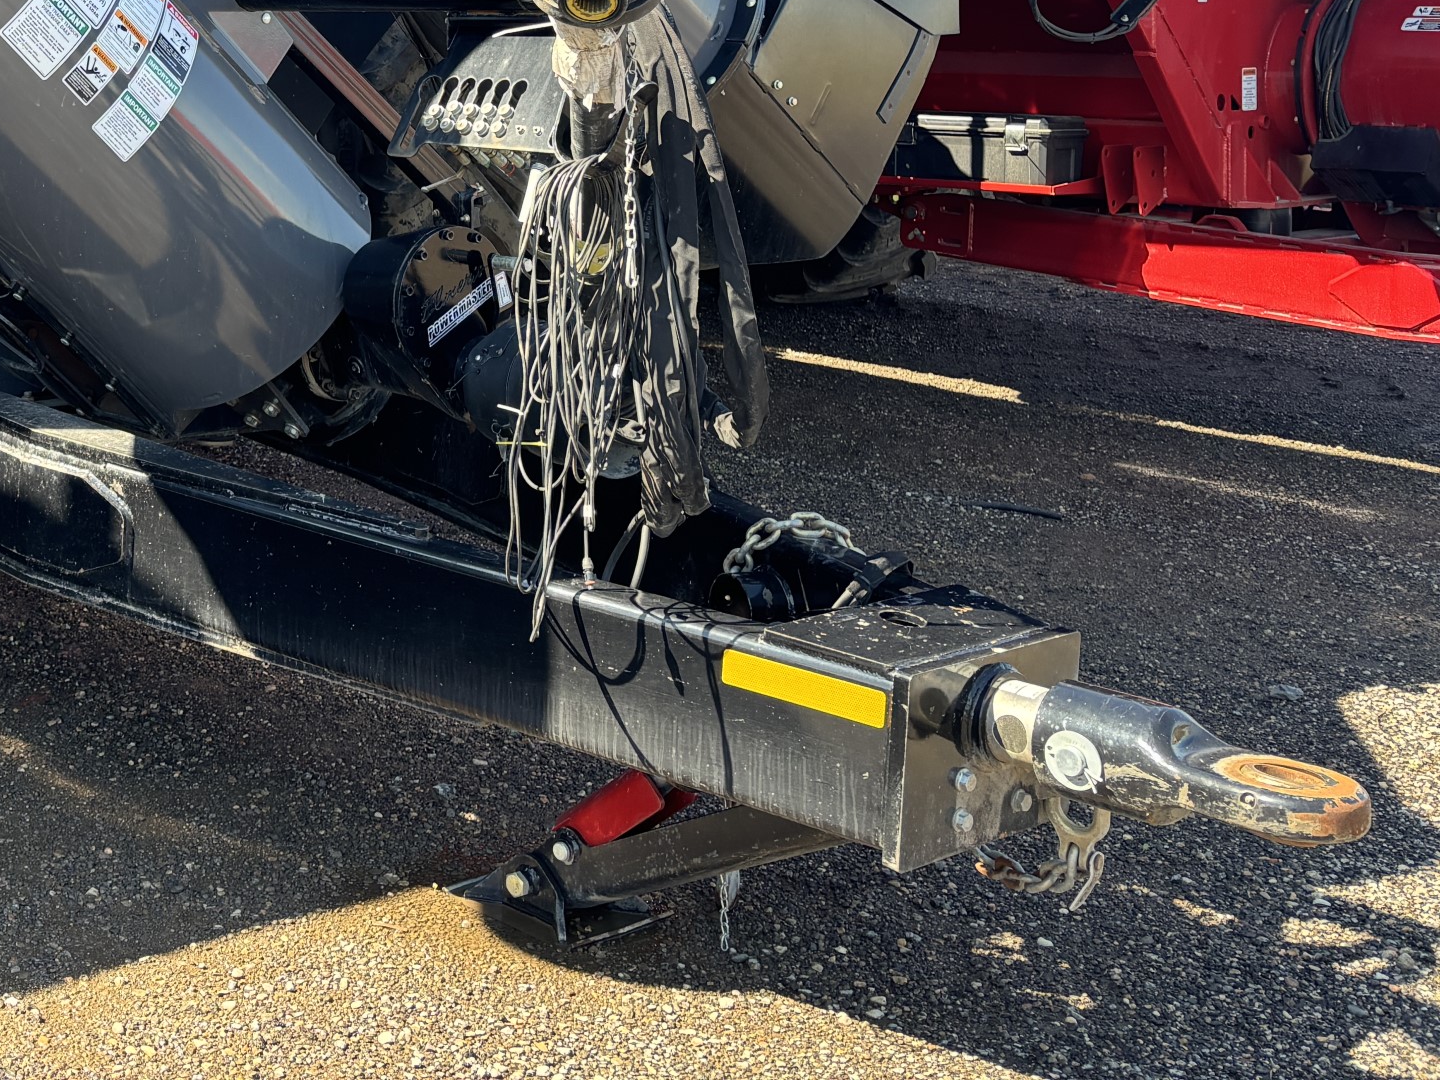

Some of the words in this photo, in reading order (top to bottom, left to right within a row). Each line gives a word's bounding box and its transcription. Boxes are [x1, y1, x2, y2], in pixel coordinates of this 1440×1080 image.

[42, 5, 61, 26] PRESSURE
[52, 9, 64, 22] TRACK
[97, 51, 116, 71] WARNING
[147, 60, 177, 92] IMPORTANT
[124, 95, 155, 128] IMPORTANT
